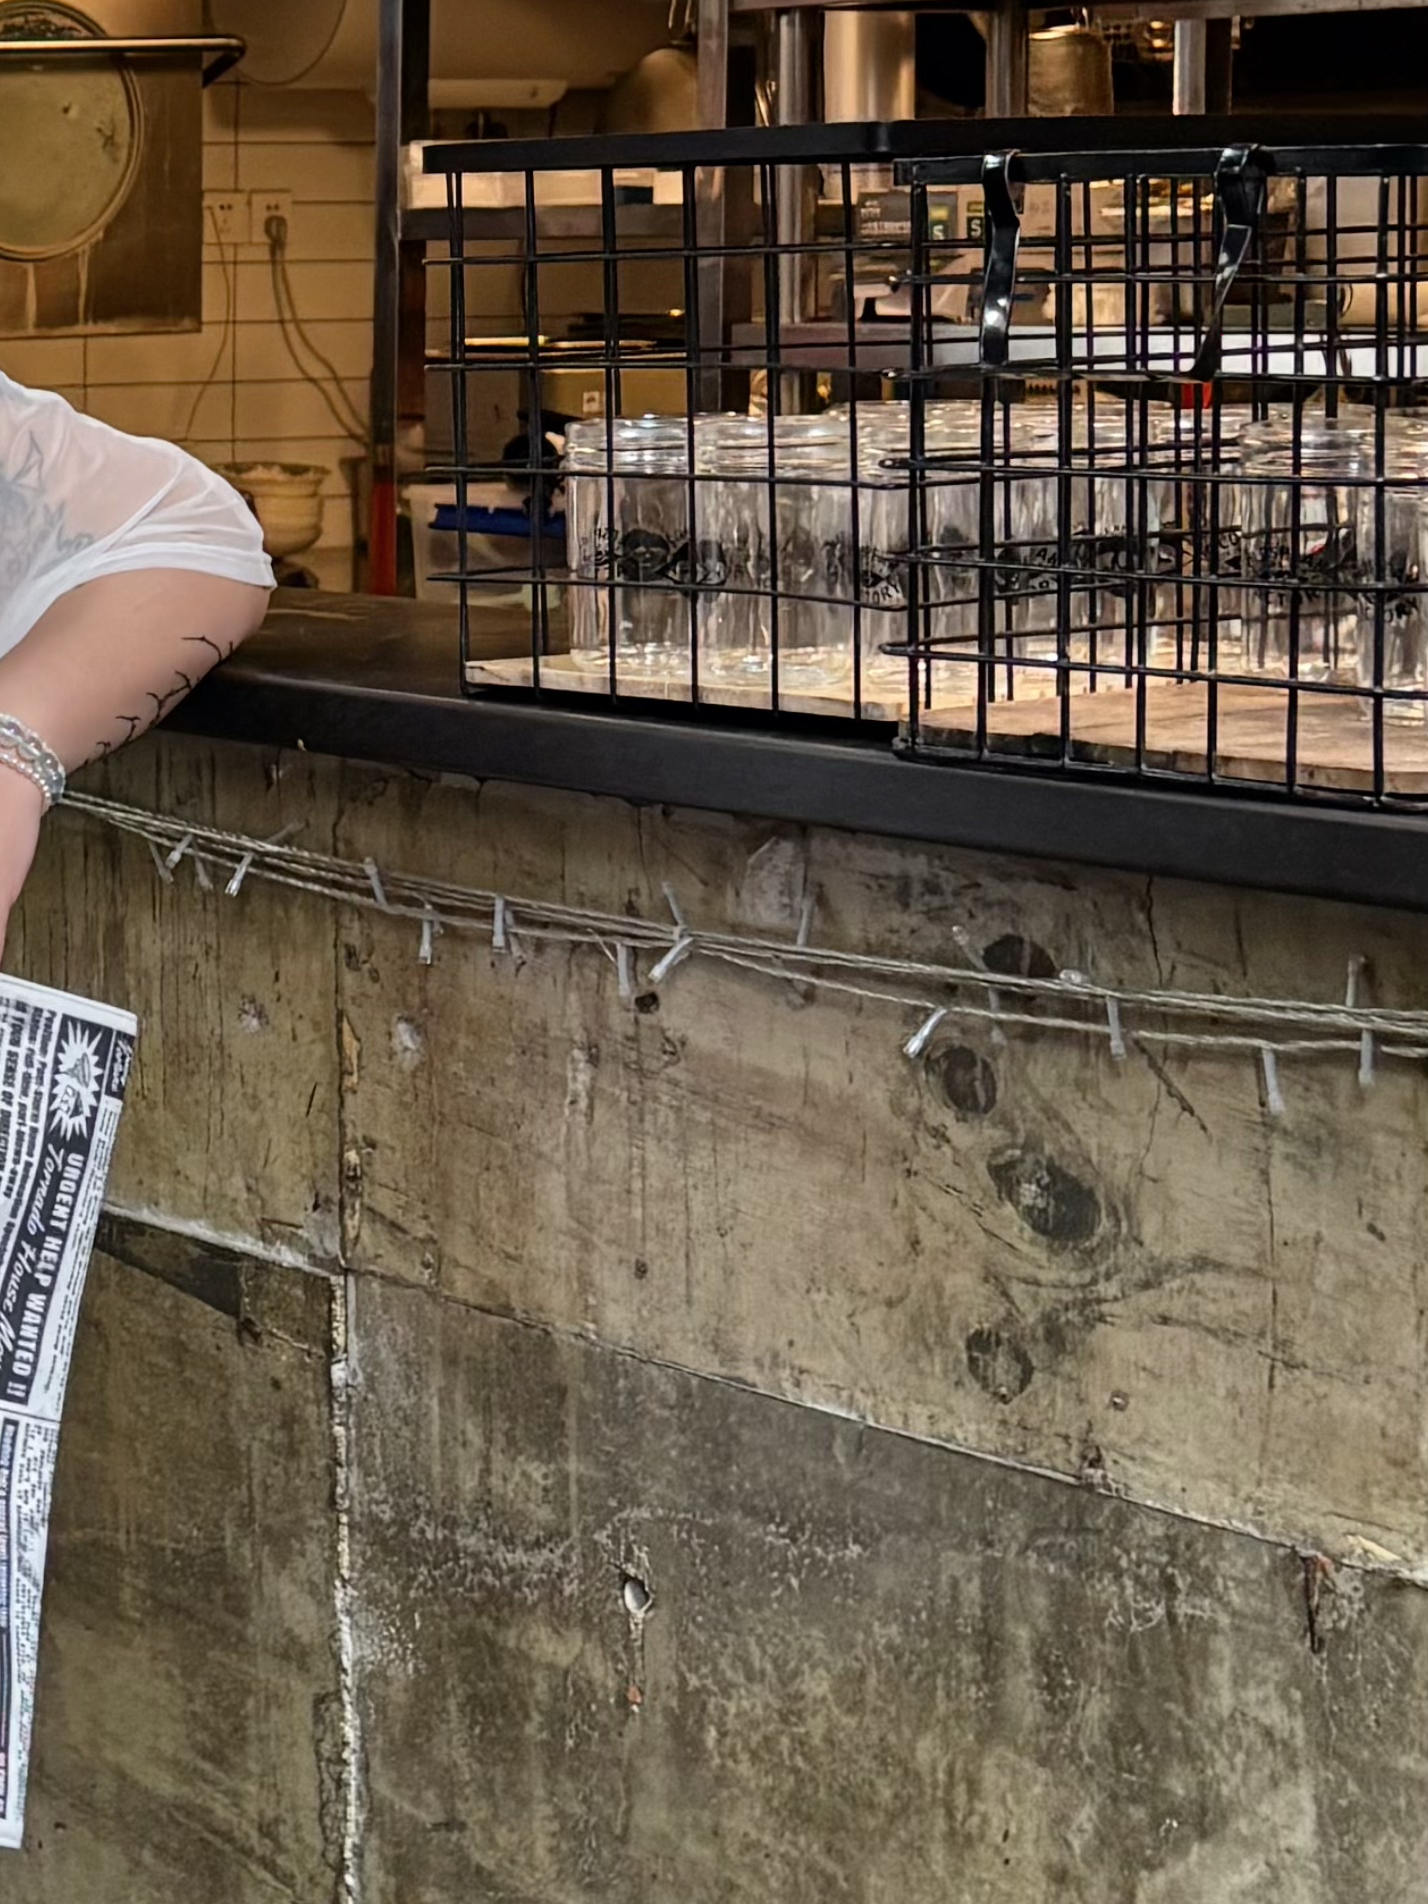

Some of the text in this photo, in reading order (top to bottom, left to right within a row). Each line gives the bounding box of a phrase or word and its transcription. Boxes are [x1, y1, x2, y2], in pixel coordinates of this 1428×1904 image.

[25, 1143, 66, 1237] Tornado
[48, 1151, 84, 1230] URGENT
[2, 1240, 39, 1315] House
[32, 1235, 63, 1287] HELP
[10, 1291, 47, 1377] WANTED
